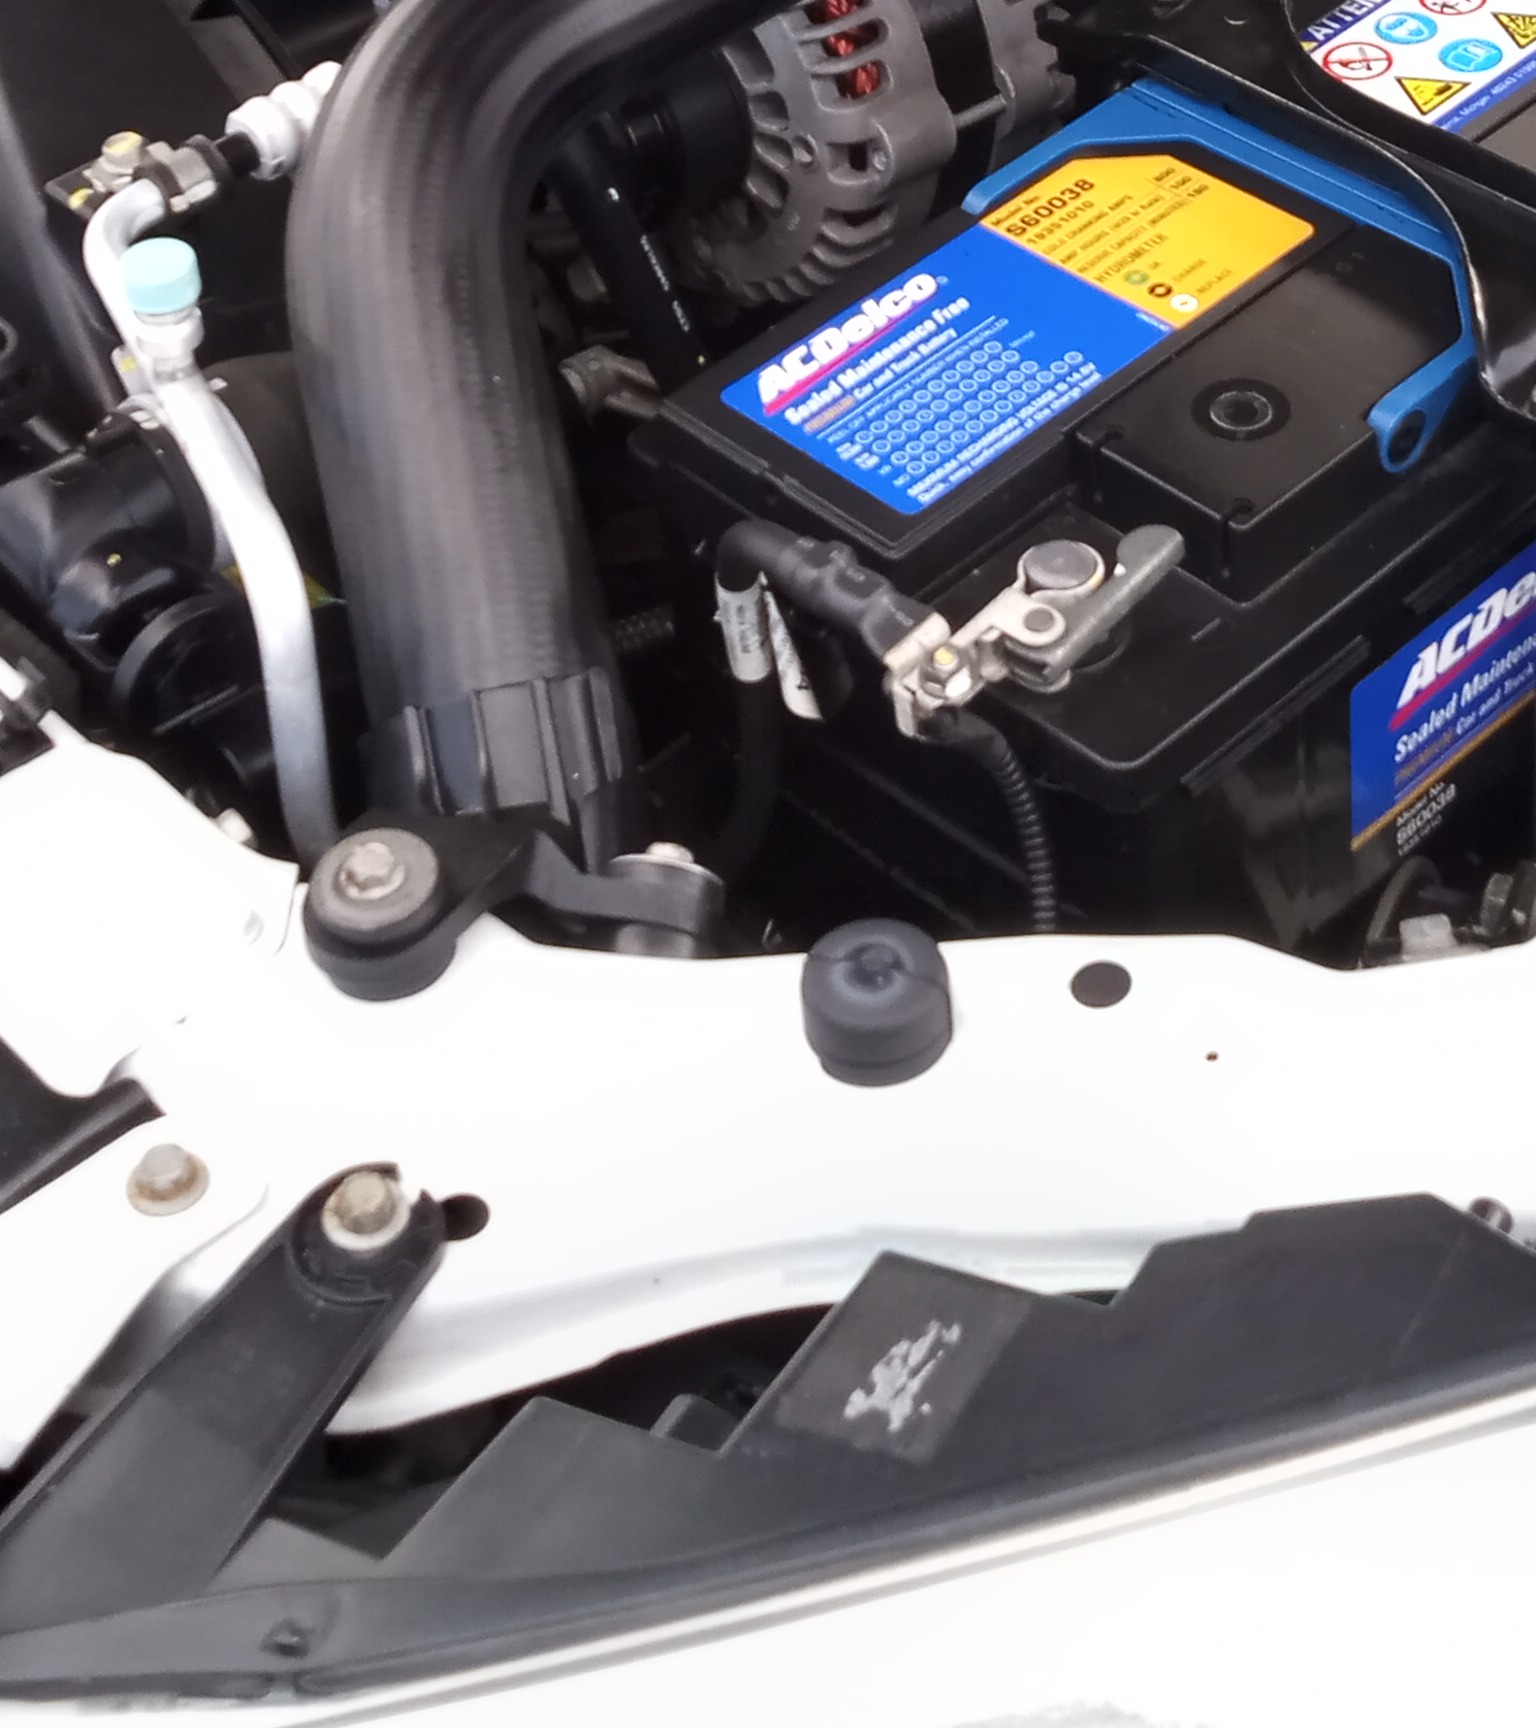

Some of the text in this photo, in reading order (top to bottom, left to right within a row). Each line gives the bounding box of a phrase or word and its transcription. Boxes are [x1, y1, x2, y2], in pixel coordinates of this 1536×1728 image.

[1006, 178, 1096, 238] S60038
[1095, 233, 1169, 284] HYDROMETER
[758, 273, 939, 404] ACDelco
[784, 297, 971, 424] Sealed Maintenance Free
[1395, 692, 1458, 762] Sealed
